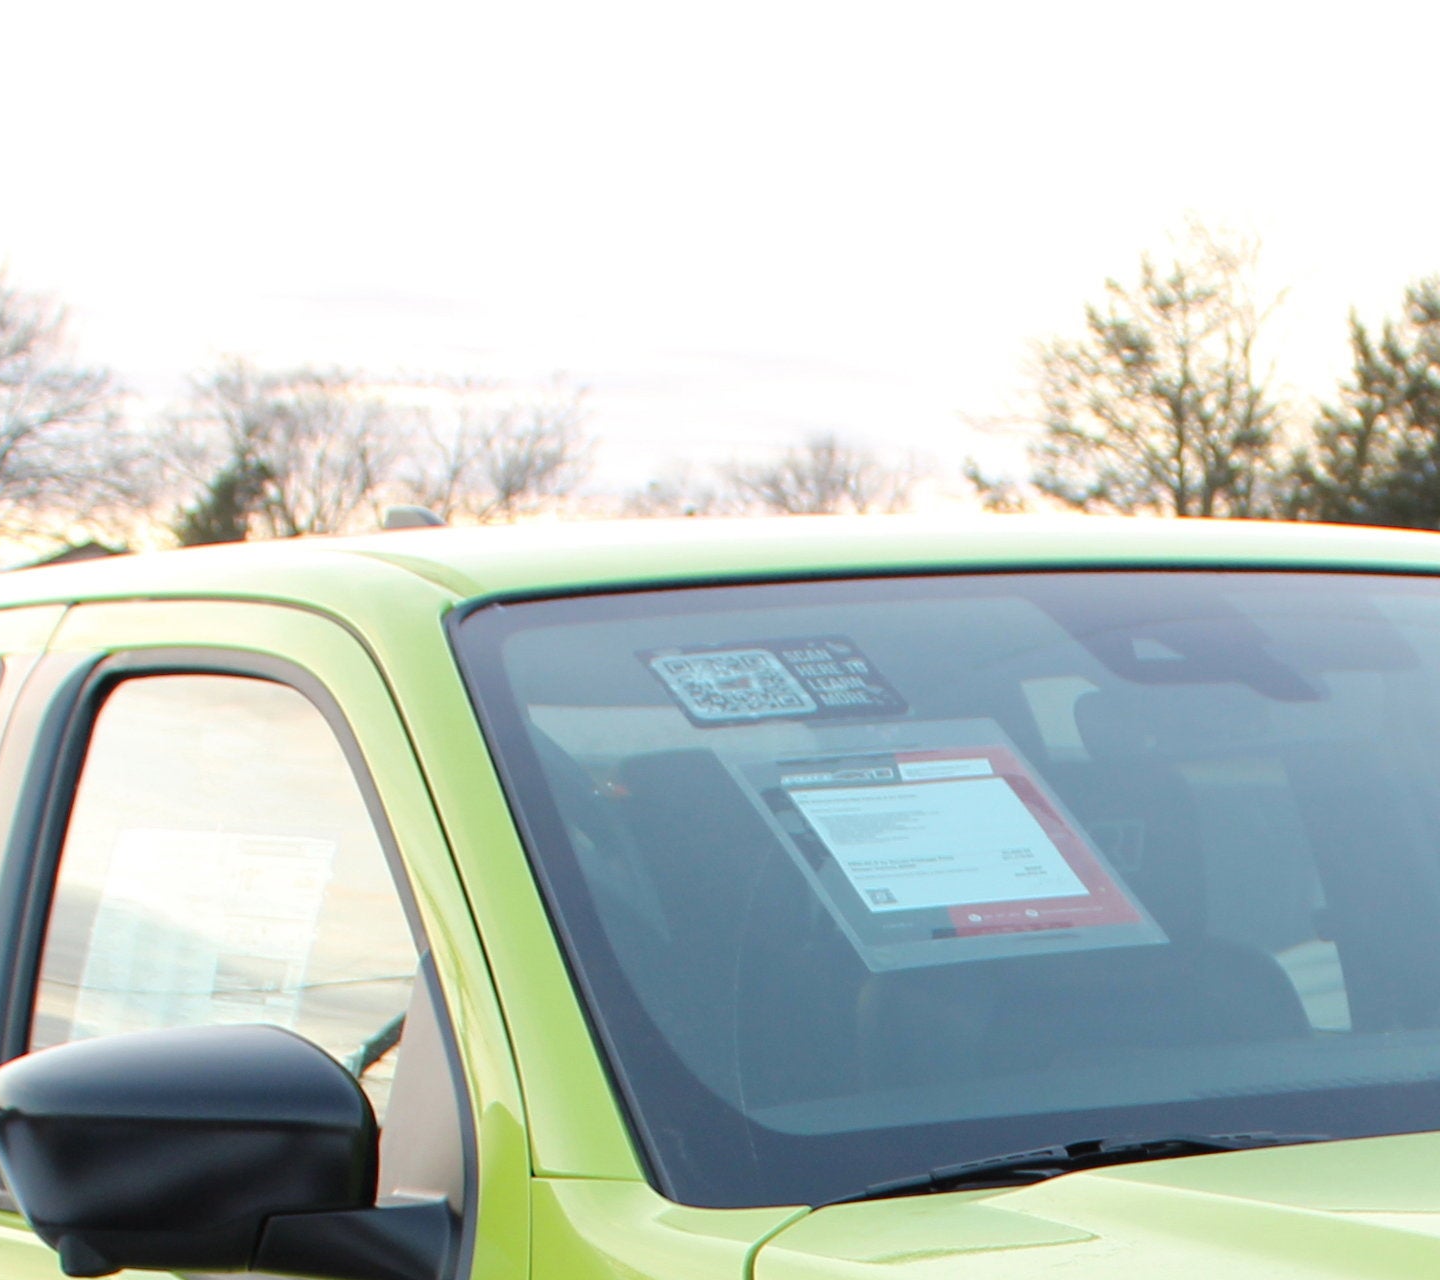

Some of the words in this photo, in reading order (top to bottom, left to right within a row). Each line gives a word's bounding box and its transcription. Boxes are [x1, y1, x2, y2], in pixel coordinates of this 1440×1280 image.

[781, 648, 833, 664] SCAN
[794, 661, 844, 676] HERE
[843, 658, 869, 674] TO
[805, 675, 866, 690] LEARN
[817, 690, 872, 706] MORE
